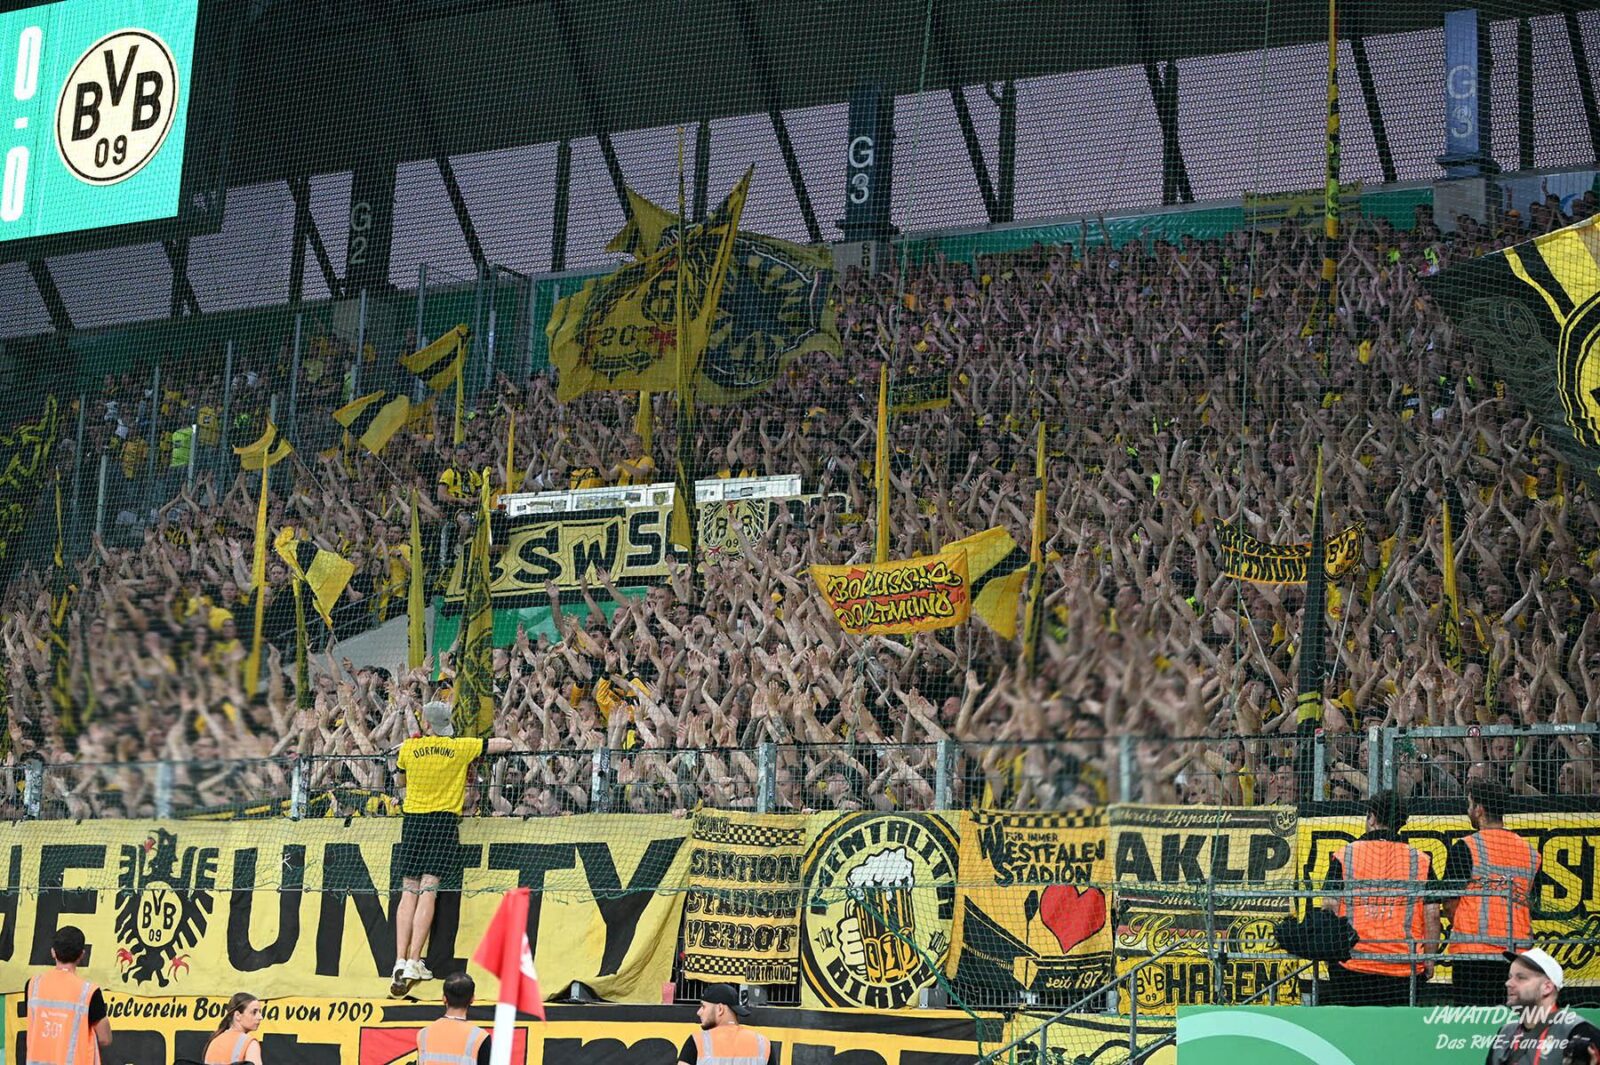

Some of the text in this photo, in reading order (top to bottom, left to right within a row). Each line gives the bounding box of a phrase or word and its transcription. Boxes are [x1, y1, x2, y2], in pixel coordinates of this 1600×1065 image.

[71, 45, 164, 141] BVB
[95, 135, 127, 168] 09
[726, 538, 739, 548] 09
[827, 562, 963, 602] BORUSSIA
[834, 590, 955, 628] DORTMUND
[413, 746, 455, 759] DORTMUND
[1277, 811, 1295, 825] BVB
[977, 821, 1106, 864] WESTFALEN
[1005, 831, 1058, 842] FÜR IMMER
[690, 848, 804, 883] SEKTION
[1115, 831, 1291, 885] AKLP
[994, 862, 1092, 887] STADION
[142, 889, 176, 929] BVB
[686, 884, 800, 918] STADION
[149, 929, 162, 941] 09
[686, 919, 797, 952] VERBOT
[745, 967, 791, 981] DORTMUND
[1046, 976, 1072, 989] seit
[1137, 967, 1164, 995] BVB
[1166, 962, 1279, 1004] HAGEN
[104, 997, 187, 1018] ielverein
[285, 1004, 321, 1021] von
[327, 1001, 374, 1022] 1909
[1146, 993, 1157, 1001] 09
